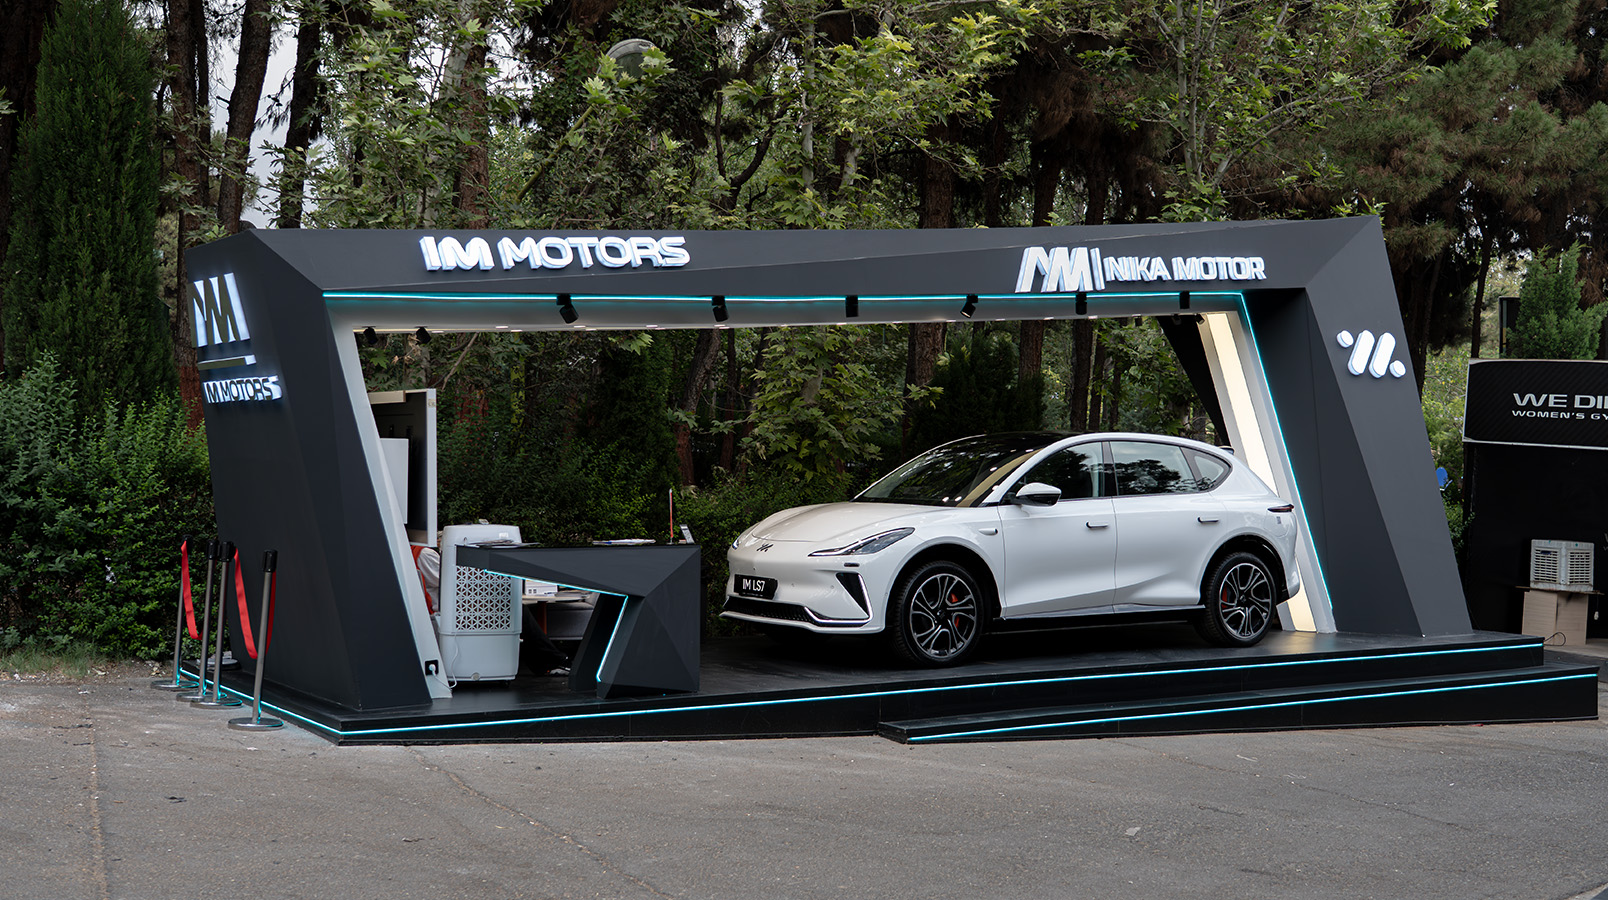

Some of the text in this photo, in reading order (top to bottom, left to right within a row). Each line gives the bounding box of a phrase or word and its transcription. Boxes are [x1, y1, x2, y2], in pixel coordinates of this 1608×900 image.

[419, 236, 691, 271] IM MOTORS
[1103, 256, 1267, 282] NIKA MOTOR
[219, 375, 282, 402] MOTORS
[1513, 393, 1608, 410] WE DI
[1511, 410, 1585, 420] WOMEN'S
[742, 578, 766, 592] IM LS7
